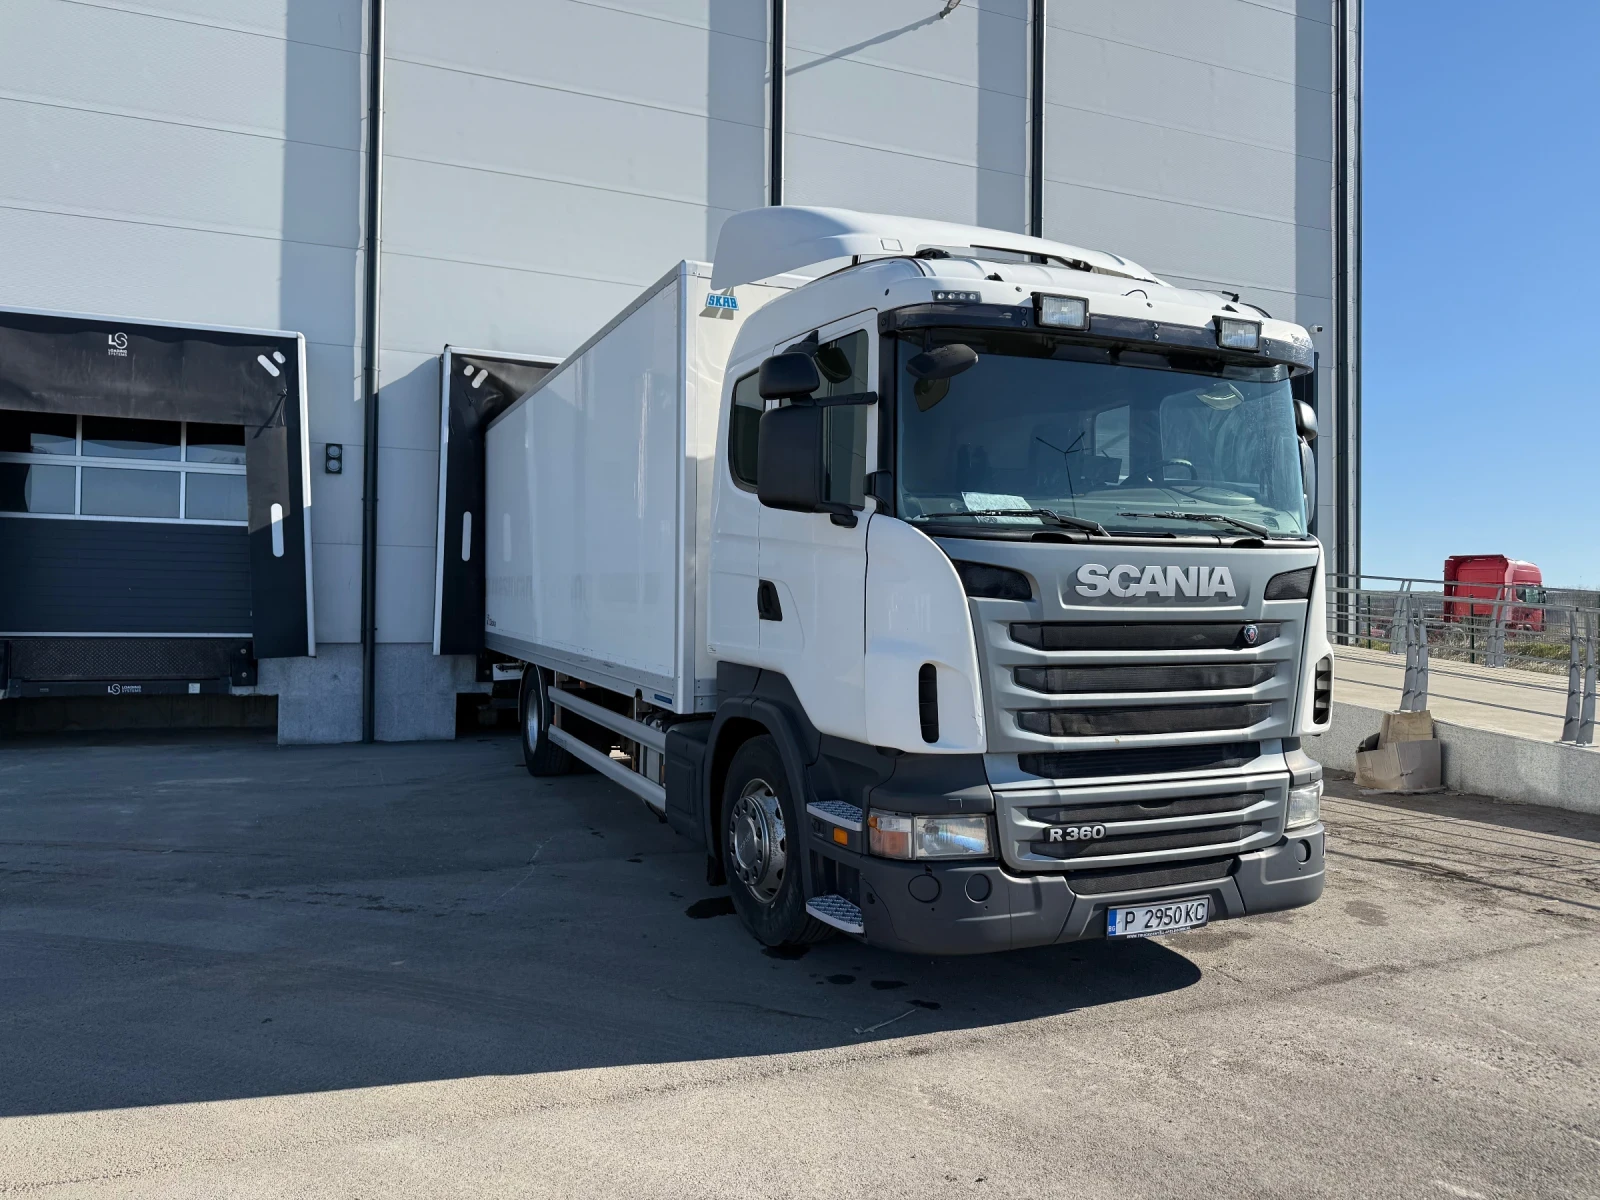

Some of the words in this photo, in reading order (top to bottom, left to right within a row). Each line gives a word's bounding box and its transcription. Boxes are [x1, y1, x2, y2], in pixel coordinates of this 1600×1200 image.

[708, 295, 738, 308] SKAB
[1075, 563, 1237, 598] SCANIA
[1124, 911, 1136, 931] P
